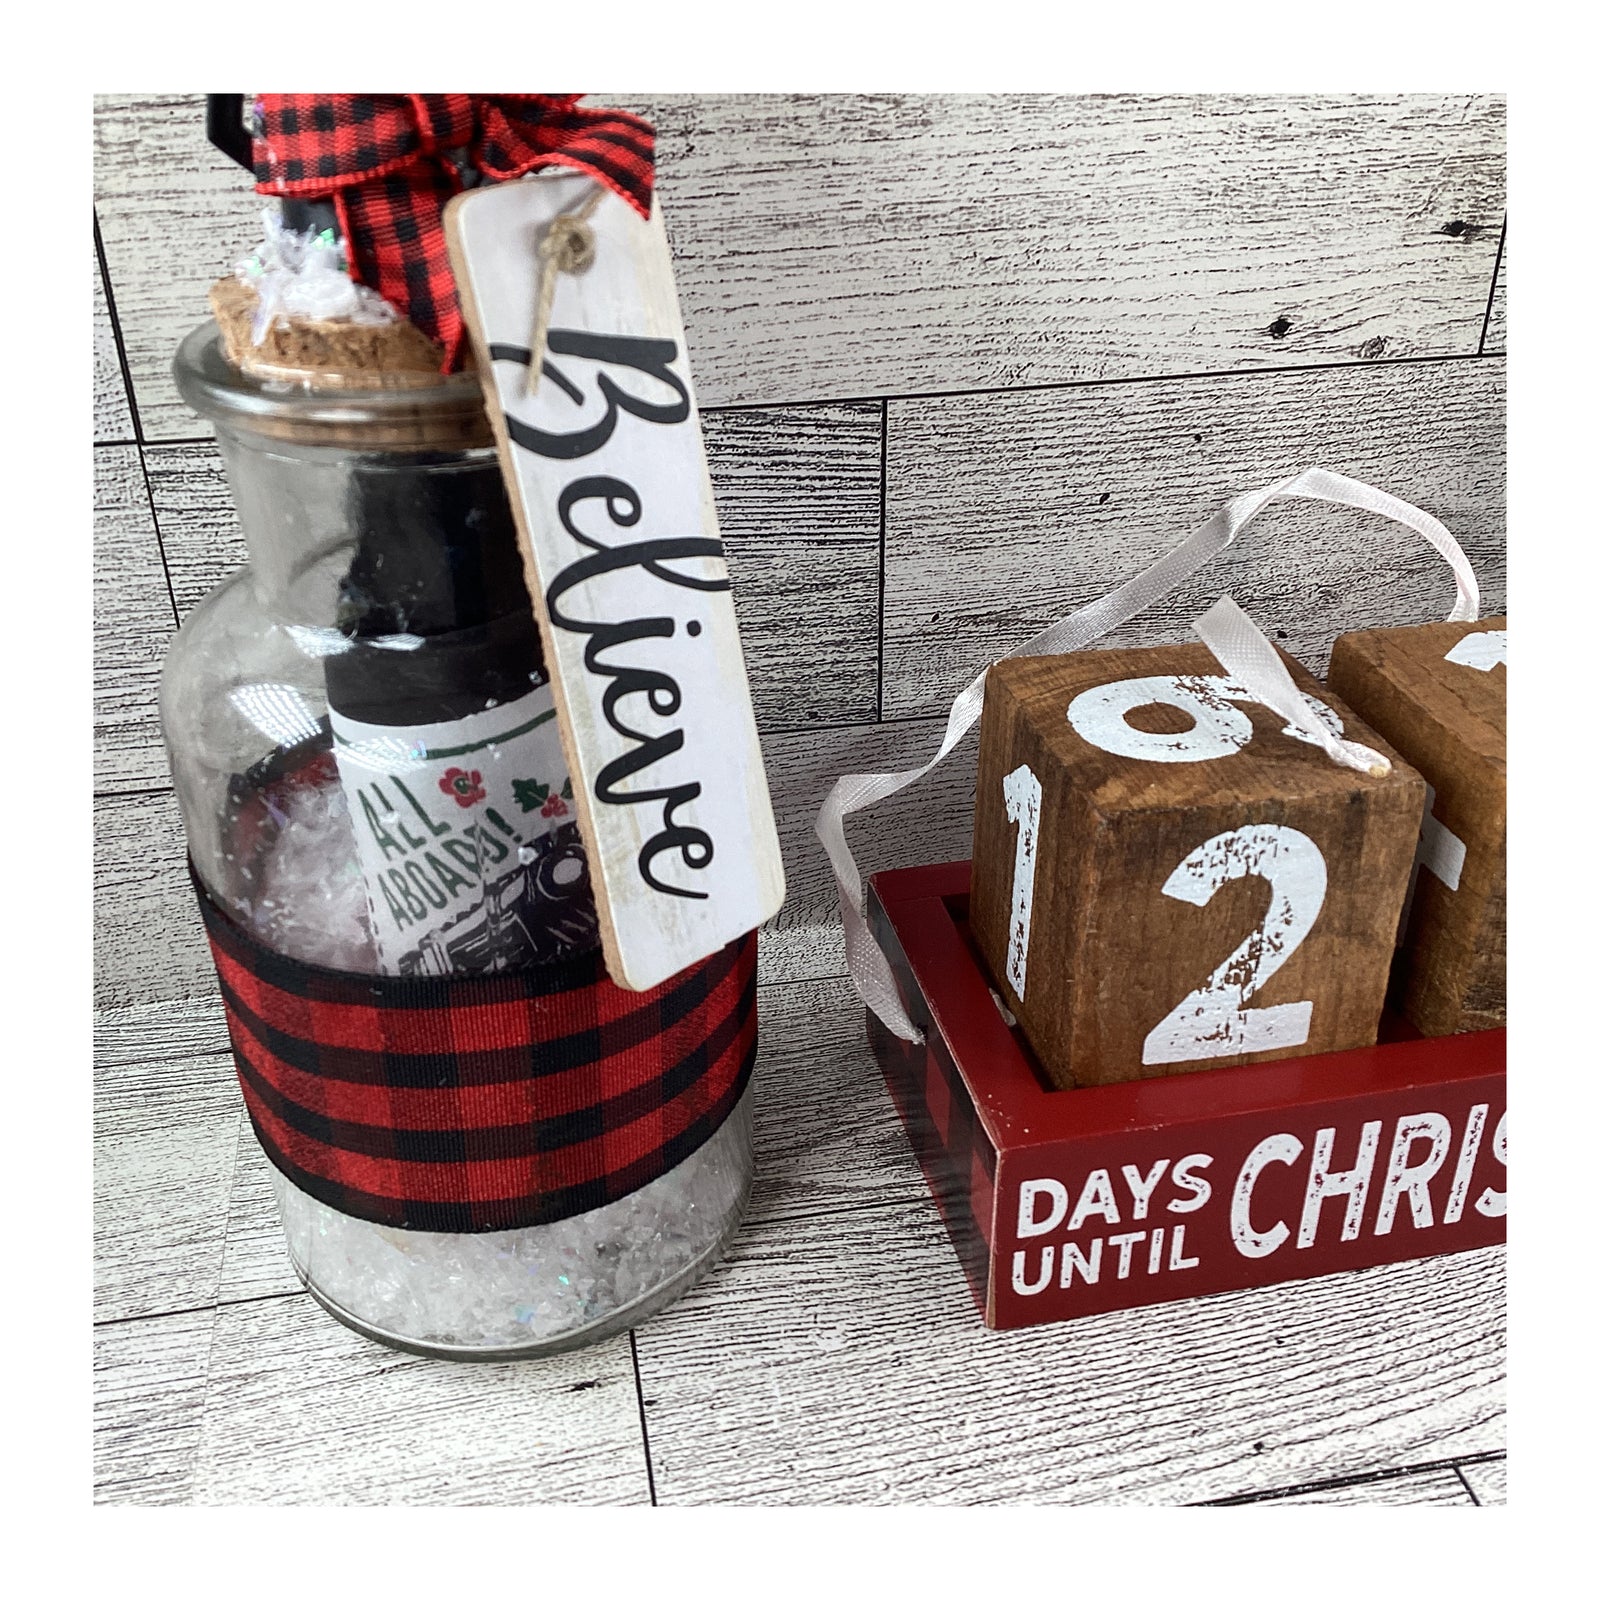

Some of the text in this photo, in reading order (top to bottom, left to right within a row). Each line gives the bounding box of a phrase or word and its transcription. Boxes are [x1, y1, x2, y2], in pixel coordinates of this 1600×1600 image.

[487, 328, 731, 900] Believe
[357, 775, 452, 861] ALL
[1002, 763, 1043, 1002] 1
[1141, 823, 1328, 1065] 2
[1011, 1224, 1200, 1296] UNTIL
[1016, 1153, 1215, 1239] DAYS
